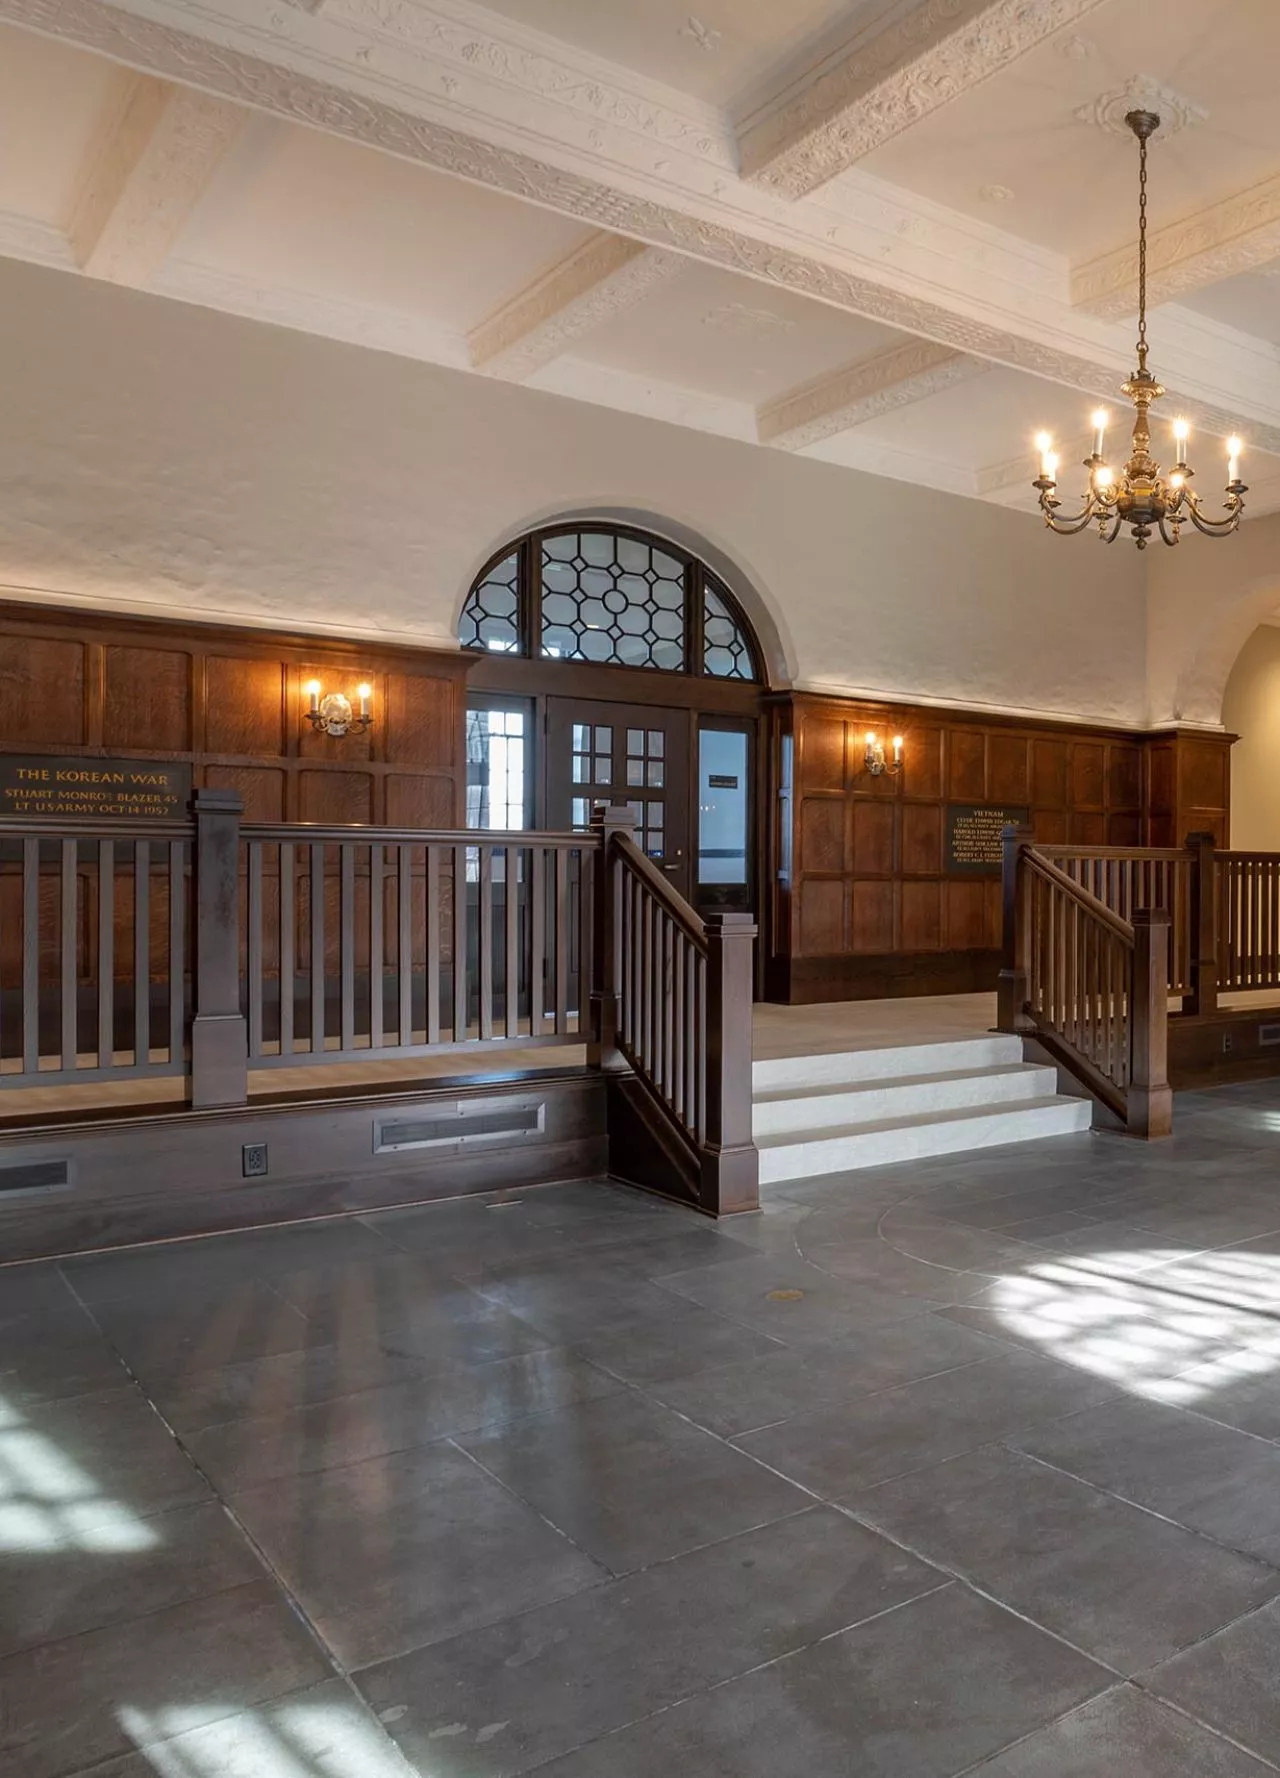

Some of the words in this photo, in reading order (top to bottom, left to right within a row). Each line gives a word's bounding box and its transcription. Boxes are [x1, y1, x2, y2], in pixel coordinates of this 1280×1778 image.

[16, 768, 50, 780] THE
[56, 770, 124, 783] KOREAN
[130, 774, 168, 785] WAR
[5, 787, 52, 799] STUART
[117, 793, 161, 803] BLAZER
[99, 804, 125, 813] OCT
[973, 810, 1004, 818] VIETNAM
